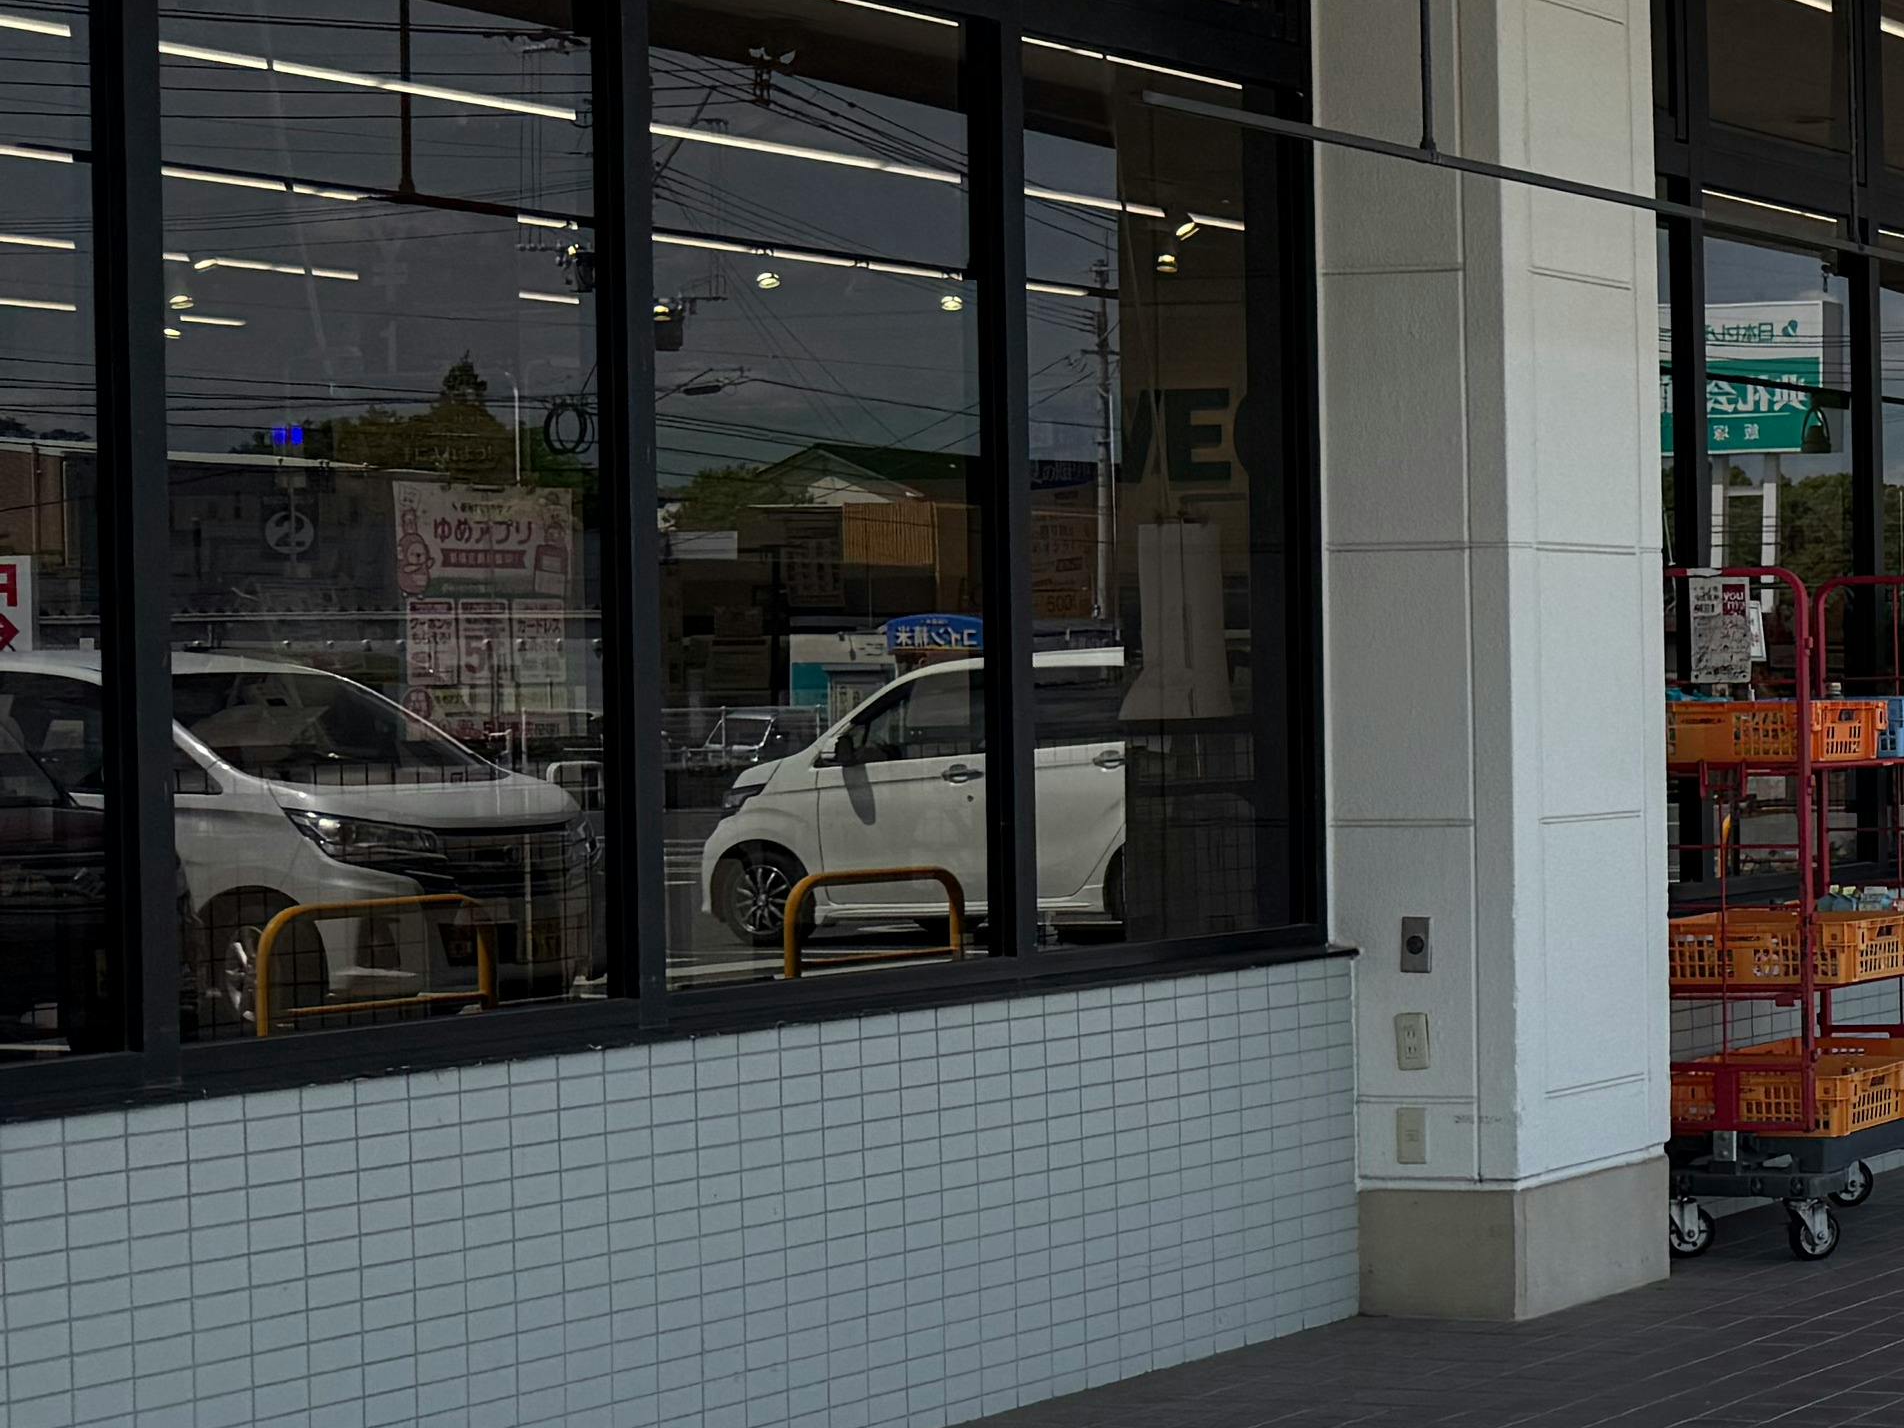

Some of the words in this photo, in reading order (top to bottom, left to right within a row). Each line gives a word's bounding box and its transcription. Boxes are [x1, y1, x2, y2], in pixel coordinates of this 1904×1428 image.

[433, 518, 533, 544] ゆめアプリ
